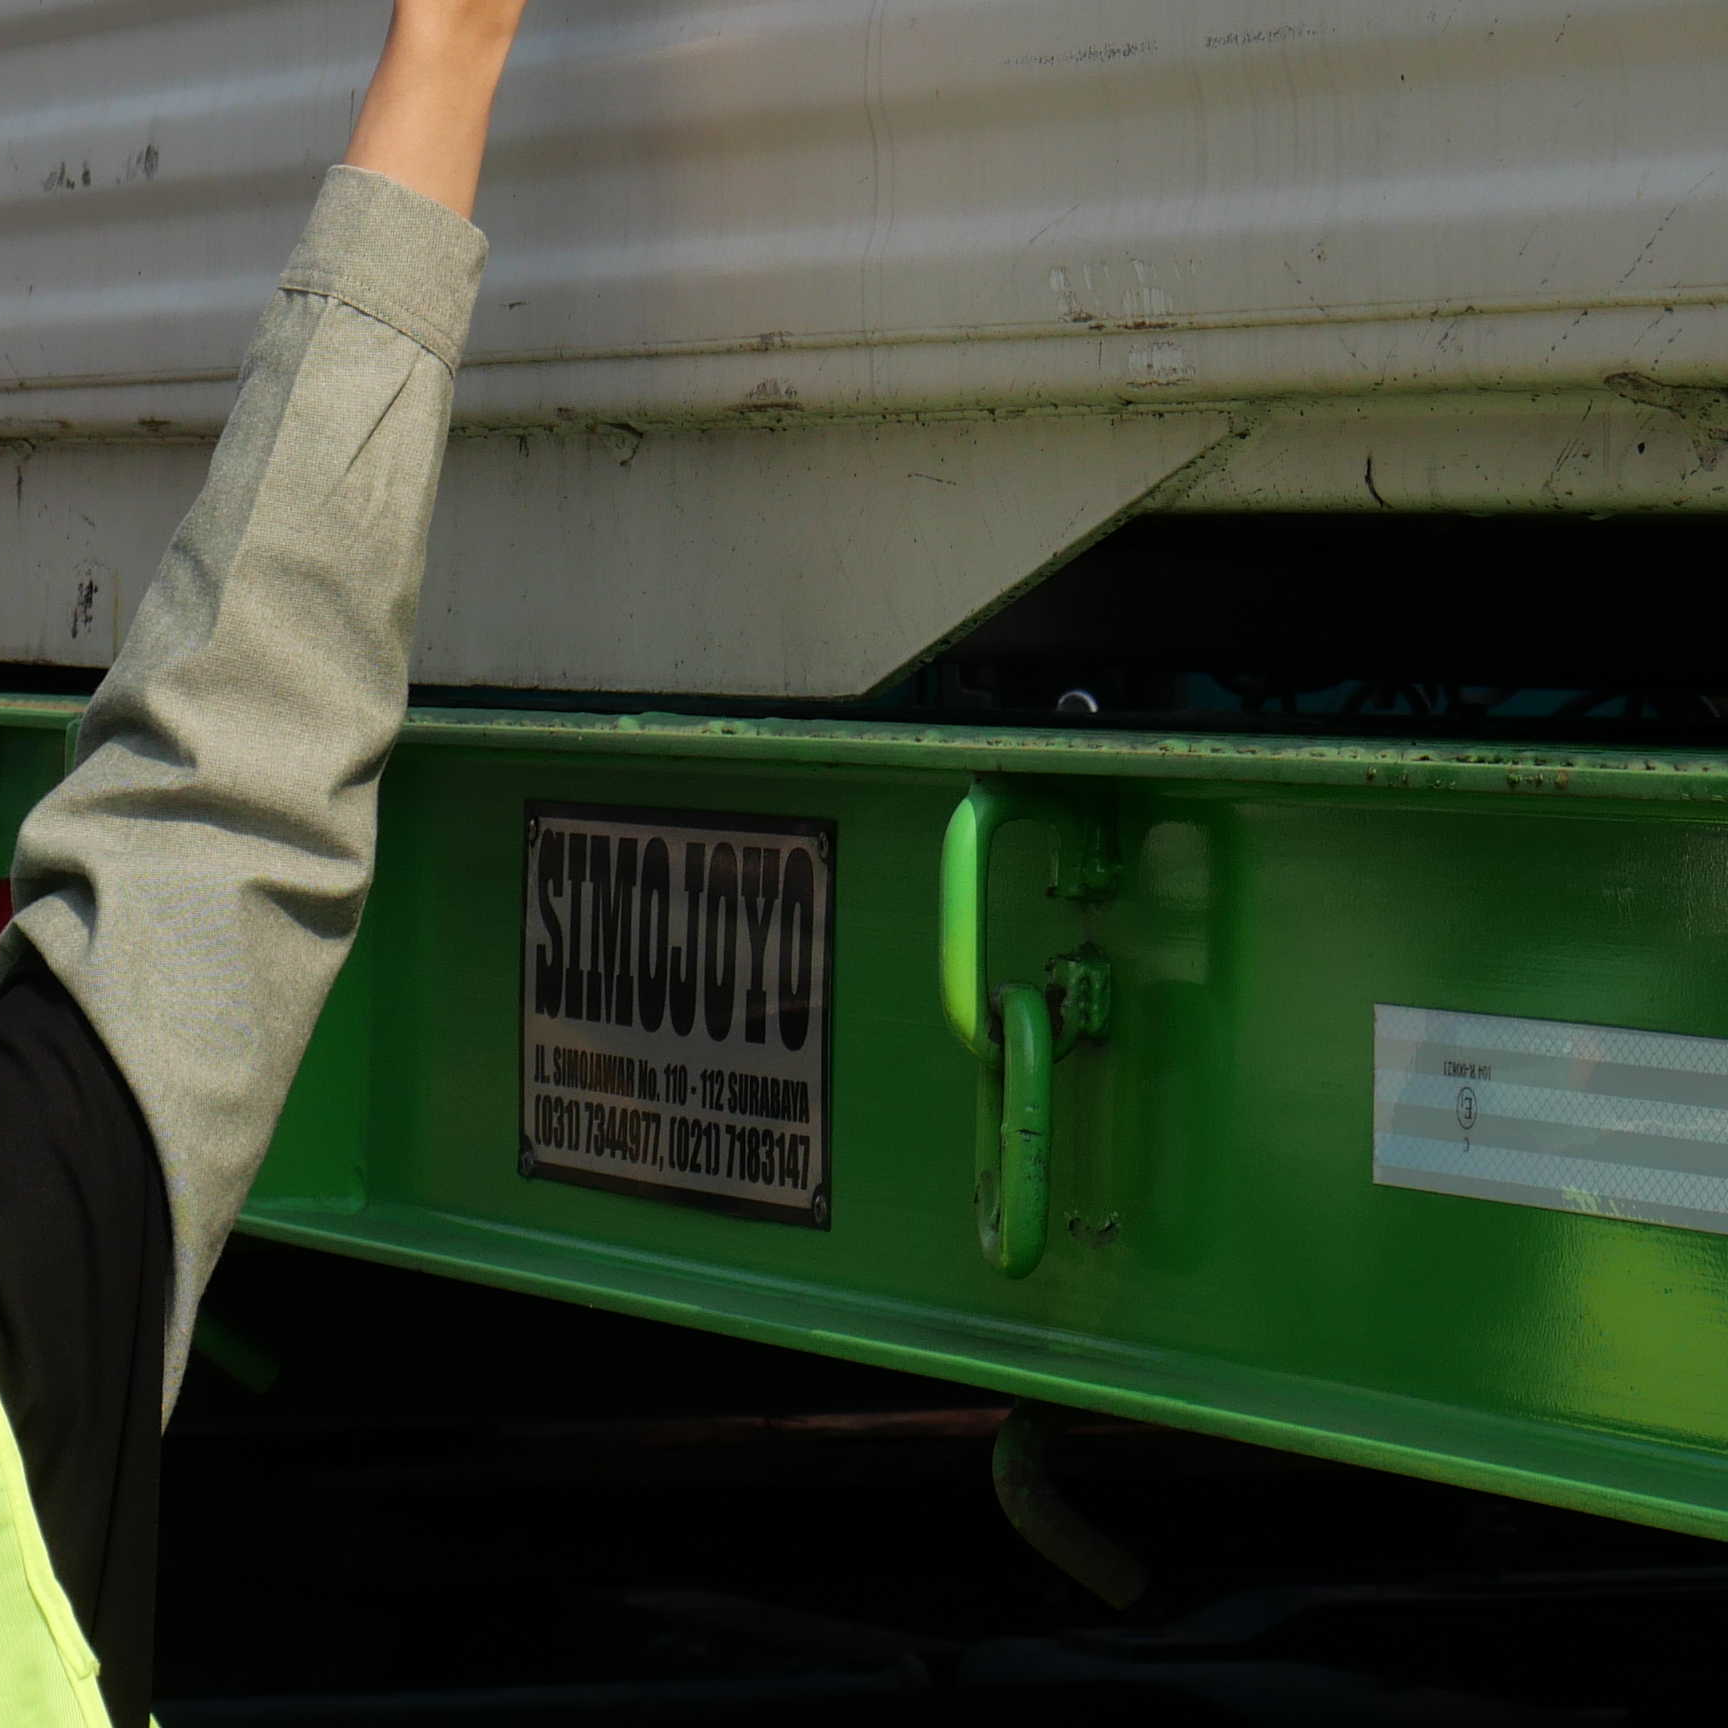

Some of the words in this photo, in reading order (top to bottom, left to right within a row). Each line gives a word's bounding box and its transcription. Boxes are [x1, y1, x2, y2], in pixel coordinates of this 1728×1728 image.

[534, 827, 815, 1053] SIMOJOYO
[534, 1044, 550, 1085] JL.
[553, 1046, 635, 1097] SIMOJAWAR
[638, 1060, 660, 1103] No.
[663, 1063, 687, 1105] 110
[700, 1069, 724, 1112] 112
[727, 1071, 810, 1124] SURABAYA
[534, 1094, 581, 1152] (031)
[584, 1101, 664, 1172] 7344977,
[668, 1114, 721, 1176] (021)
[725, 1123, 811, 1191] 7183147
